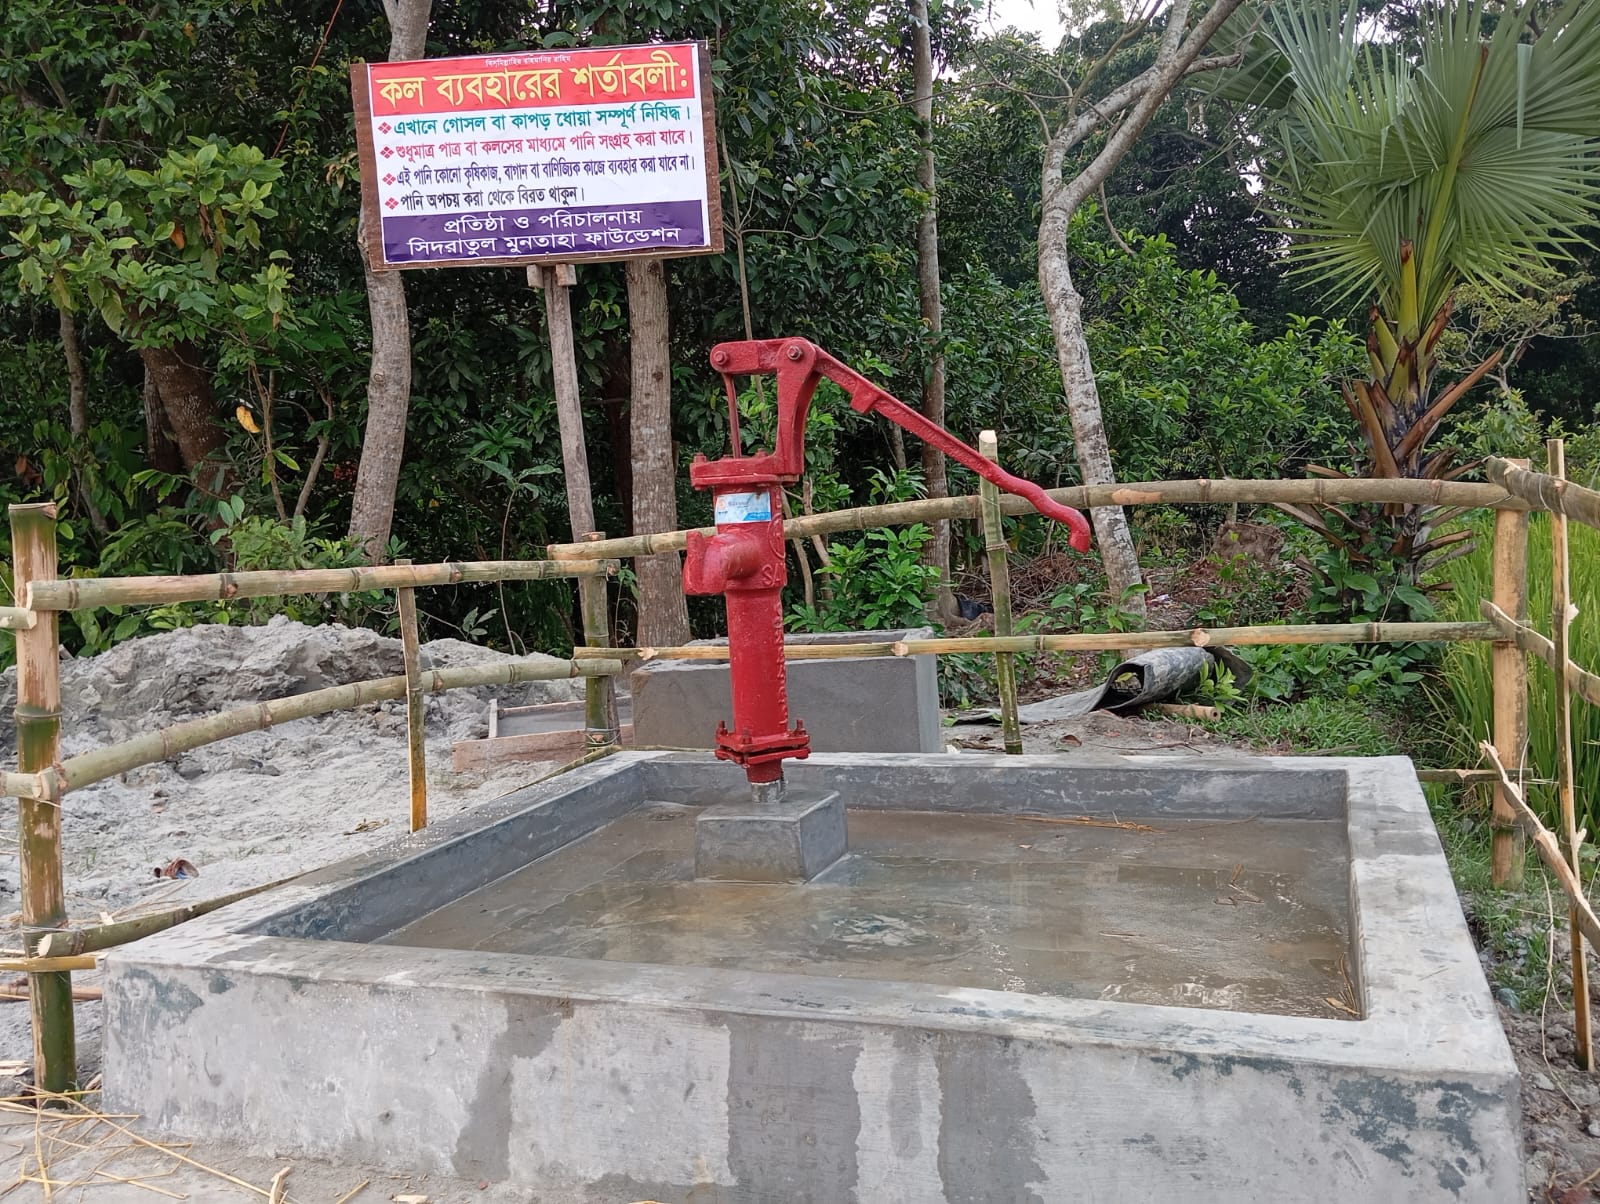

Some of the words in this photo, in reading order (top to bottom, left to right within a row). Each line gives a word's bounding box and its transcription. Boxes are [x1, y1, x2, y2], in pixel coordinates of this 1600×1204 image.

[375, 76, 427, 109] কল
[432, 68, 563, 106] ব্যবহারের
[394, 117, 437, 136] এখানে
[443, 115, 486, 133] গোসল
[490, 113, 506, 130] বা
[511, 112, 551, 130] কাপড়
[555, 109, 591, 128] ধোয়া
[595, 102, 637, 128] সম্পূর্ণ
[395, 143, 435, 163] শুধুমাত্র
[438, 140, 462, 158] পাত্র
[464, 139, 477, 156] বা
[480, 138, 523, 155] কলসের
[526, 135, 566, 153] মাধ্যমে
[569, 131, 595, 151] পানি
[598, 132, 632, 150] সংগ্রহ
[633, 129, 656, 147] করা
[397, 166, 411, 187] এই
[413, 164, 433, 185] পানি
[434, 165, 462, 185] কোনো
[463, 161, 502, 189] কৃষিকাজ,
[503, 162, 529, 182] বাগান
[530, 160, 540, 179] বা
[542, 156, 581, 178] বাণিজ্যিক
[582, 158, 605, 176] কাজে
[607, 157, 638, 176] ব্যবহার
[639, 155, 656, 173] করা
[658, 154, 678, 172] যাবে
[400, 190, 424, 211] পানি
[427, 191, 461, 210] অপচয়
[463, 189, 484, 207] করা
[487, 188, 515, 206] থেকে
[517, 184, 546, 204] বিরত
[443, 212, 506, 235] প্রতিষ্ঠা
[513, 215, 530, 229] ও
[538, 208, 643, 229] পরিচালনায়
[406, 237, 498, 256] সিদরাতুল
[502, 231, 578, 254] মুনতাহা
[583, 226, 682, 246] ফাউন্ডেশন
